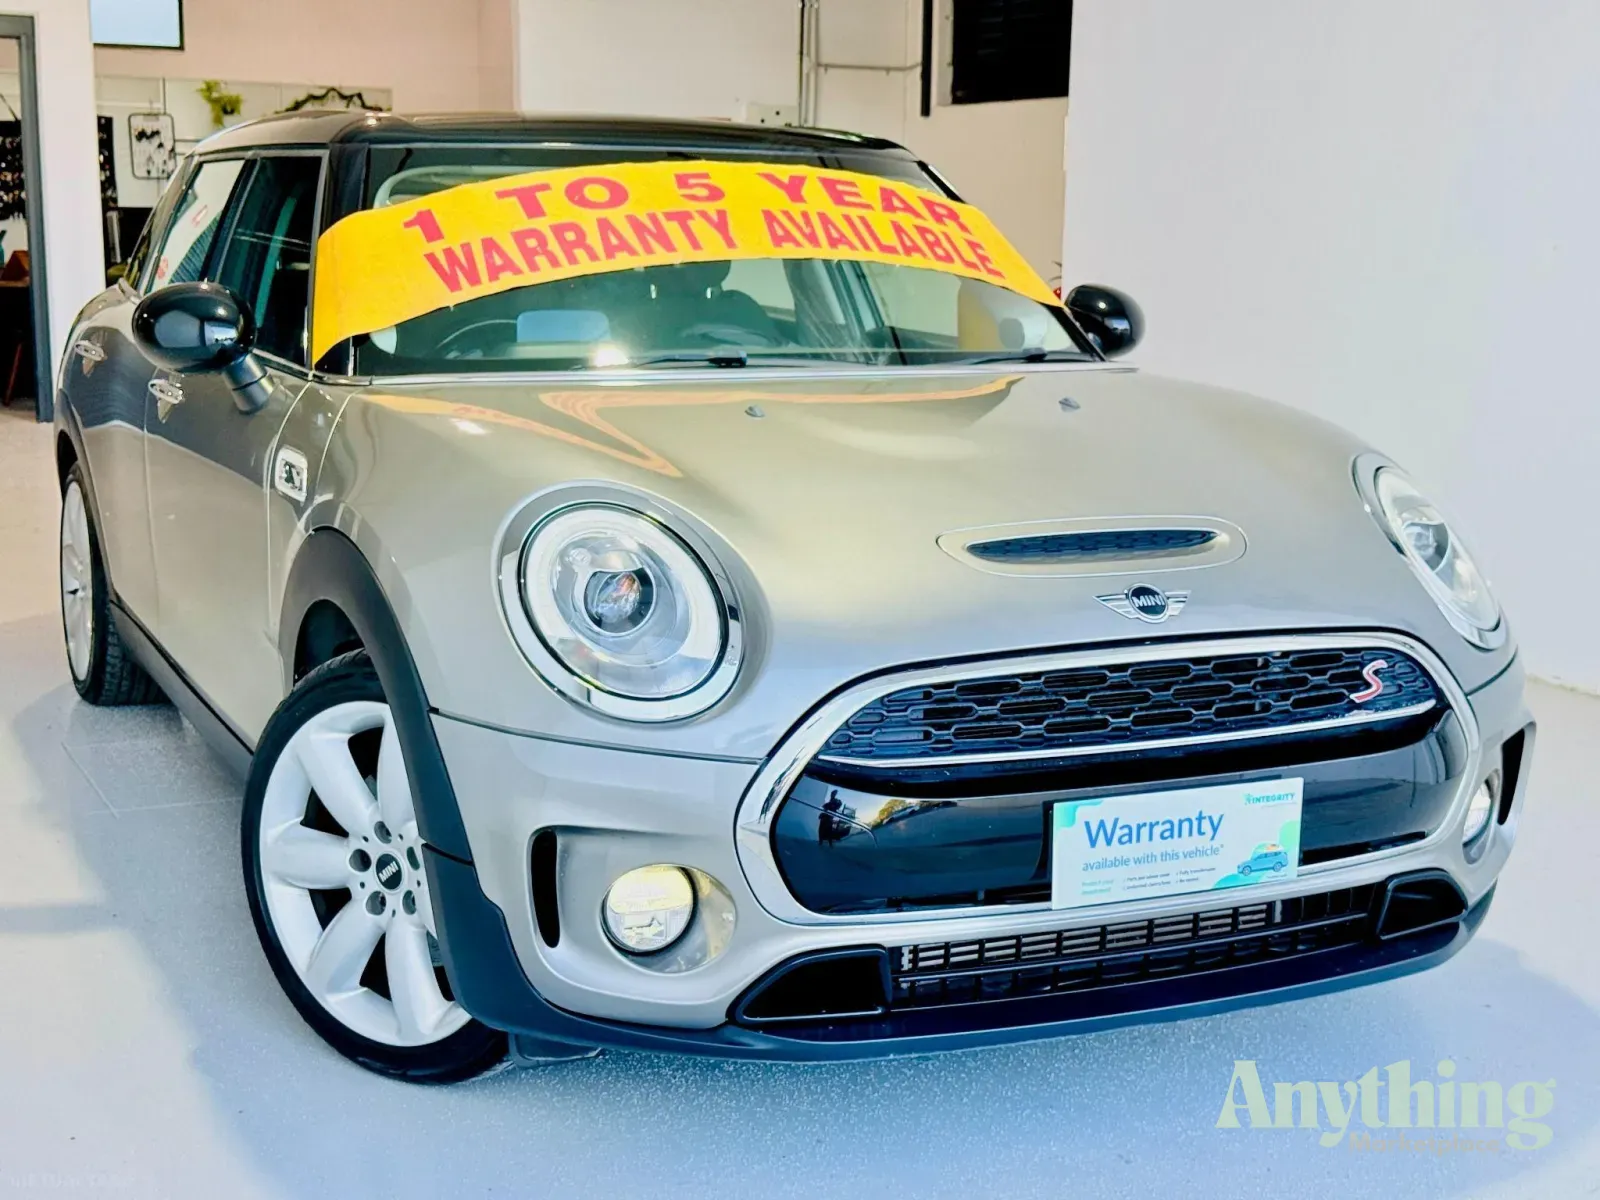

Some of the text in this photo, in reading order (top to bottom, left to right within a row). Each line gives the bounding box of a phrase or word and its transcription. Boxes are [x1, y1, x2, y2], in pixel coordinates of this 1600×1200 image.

[403, 172, 973, 244] 1 TO 5 YEAR
[424, 209, 1006, 293] WARRANTY AVAILABLE
[1132, 594, 1166, 607] MINI
[1349, 659, 1389, 703] S
[1252, 792, 1296, 804] INTEGRITY
[1084, 810, 1224, 849] Warranty
[378, 860, 399, 883] MINI
[1082, 855, 1131, 872] available
[1132, 852, 1157, 866] with
[1160, 849, 1180, 862] this
